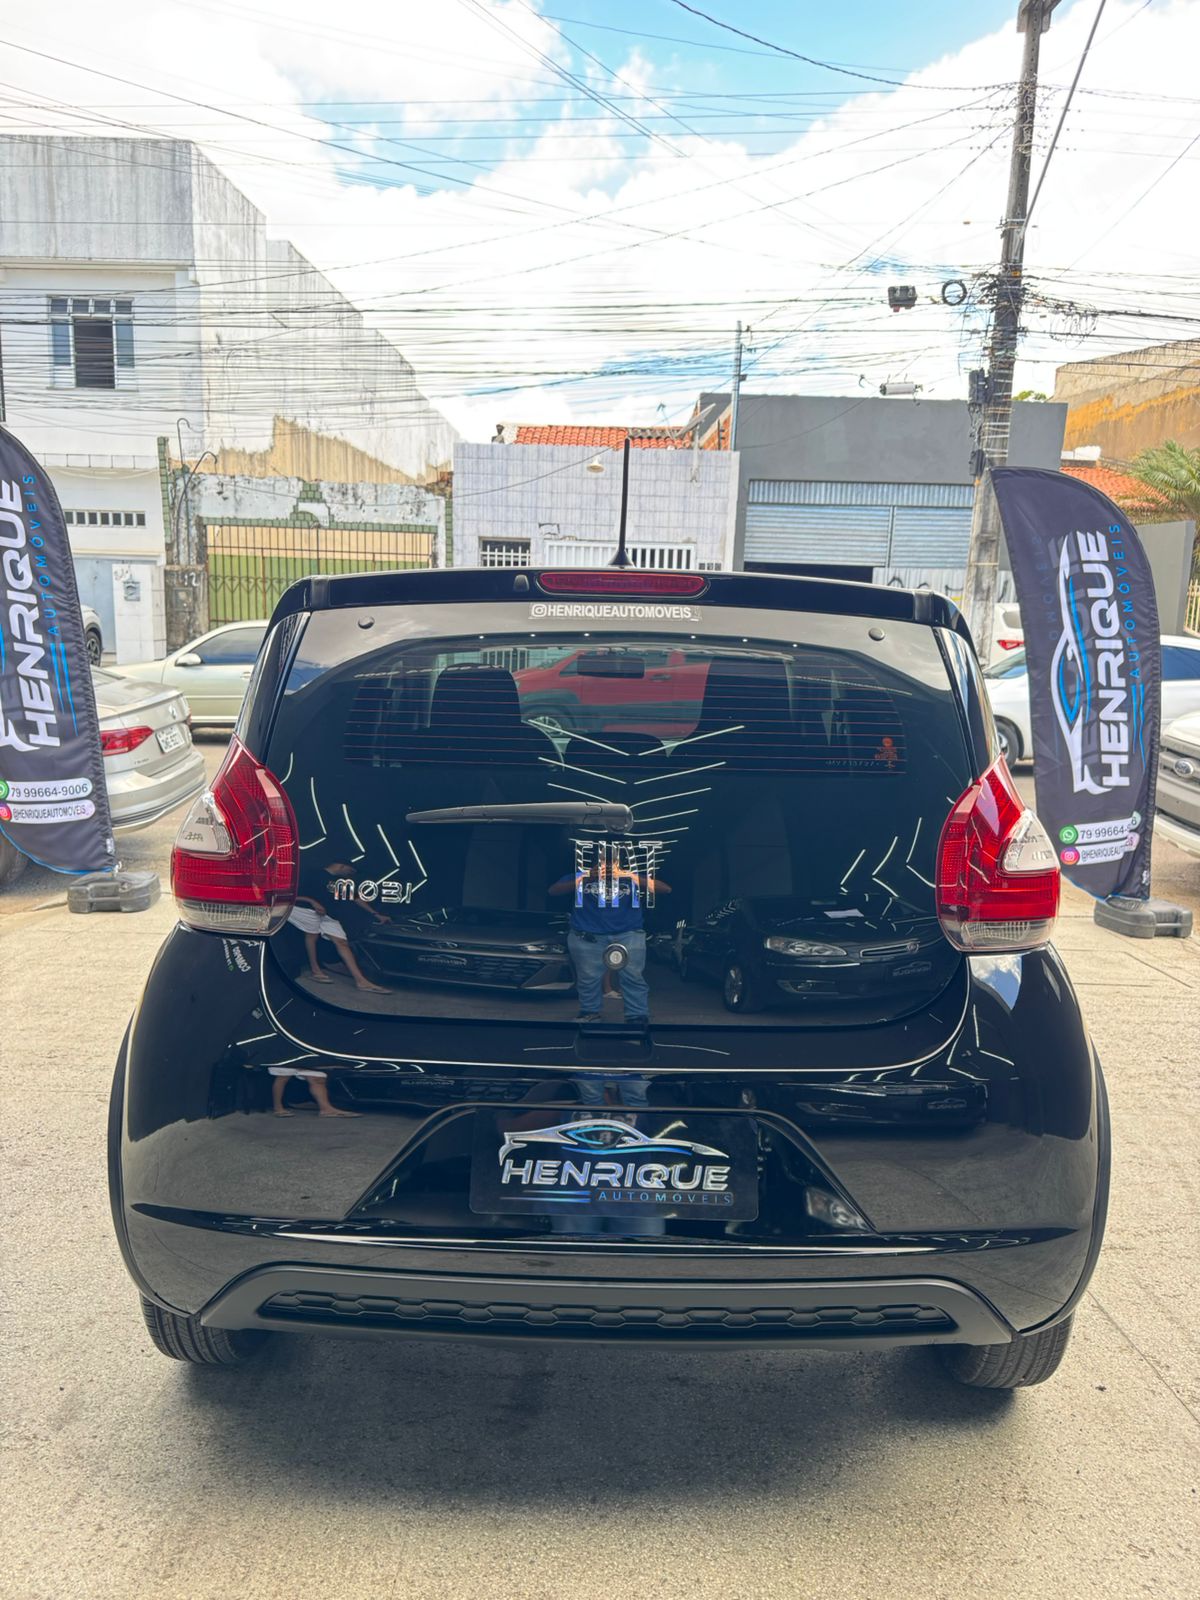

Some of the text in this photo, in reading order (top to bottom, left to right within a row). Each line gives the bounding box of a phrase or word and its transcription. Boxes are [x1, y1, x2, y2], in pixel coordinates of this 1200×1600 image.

[1076, 530, 1131, 787] HENRIQUE
[11, 783, 89, 799] 79 99664-9006
[1080, 829, 1093, 840] 79
[574, 840, 663, 909] FIAT
[501, 1159, 731, 1191] HENRIQUE
